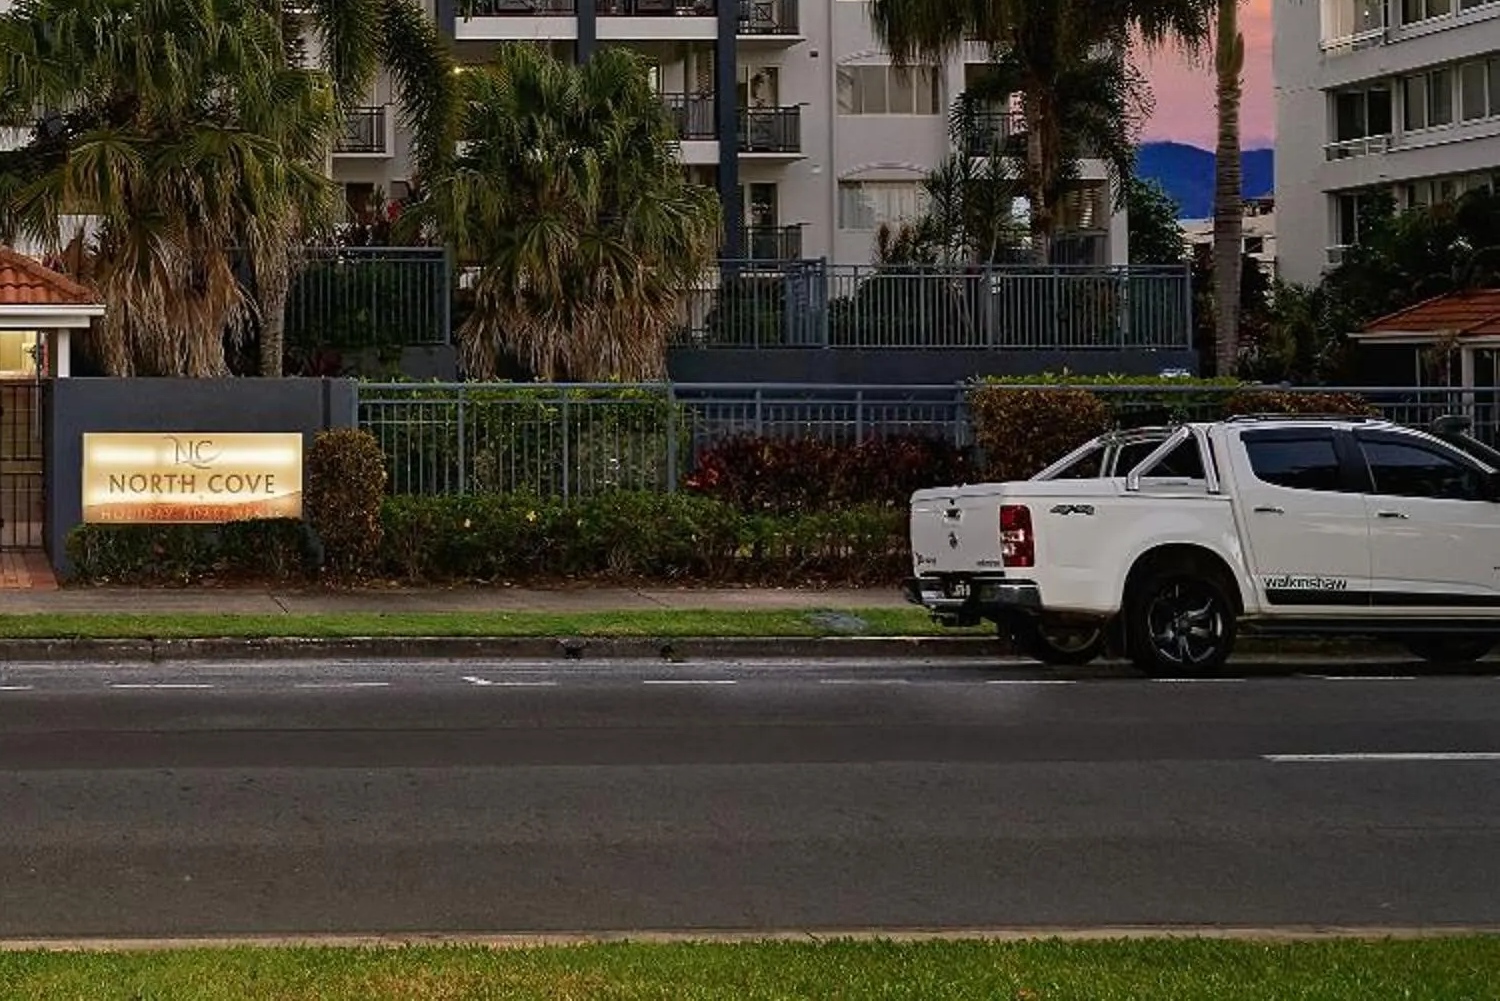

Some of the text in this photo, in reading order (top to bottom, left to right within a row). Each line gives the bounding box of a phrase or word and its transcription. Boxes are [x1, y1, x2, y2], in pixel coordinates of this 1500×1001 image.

[164, 435, 221, 469] NC
[109, 474, 275, 494] NORTH COVE
[1263, 575, 1347, 590] walkinshaw
